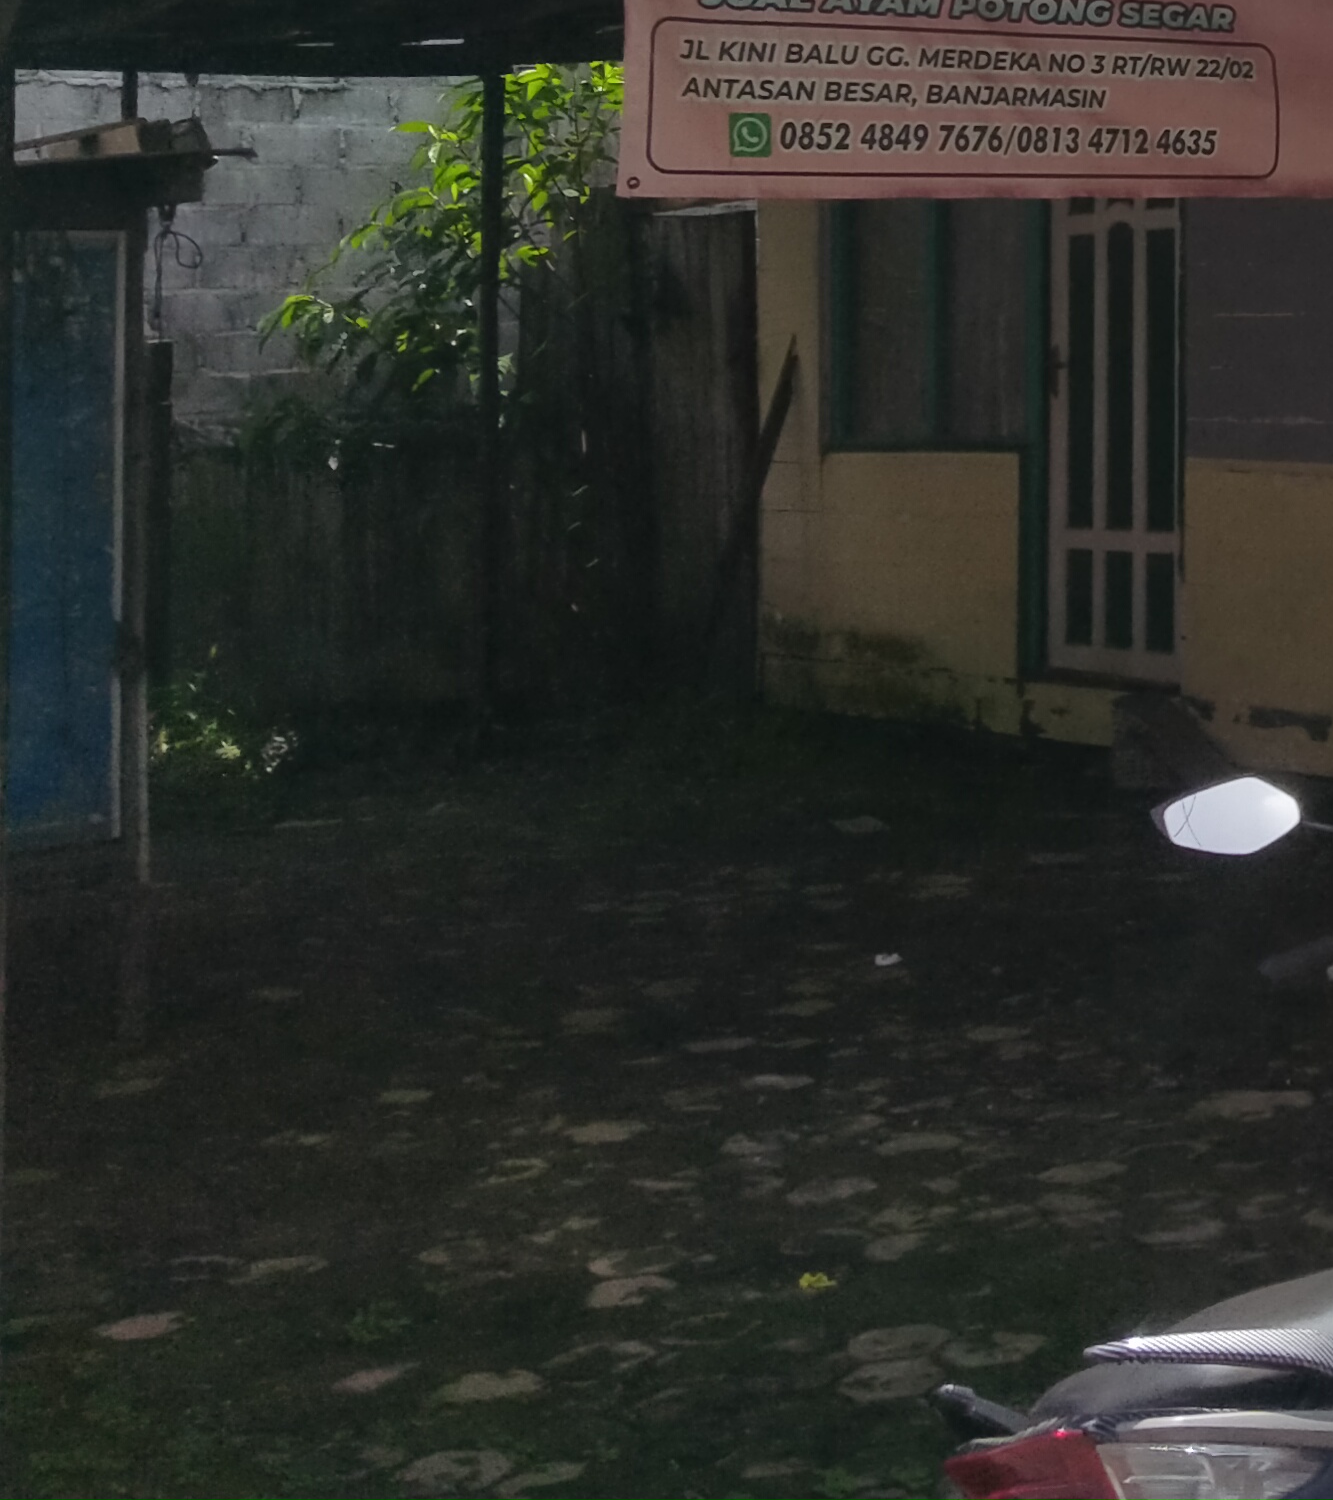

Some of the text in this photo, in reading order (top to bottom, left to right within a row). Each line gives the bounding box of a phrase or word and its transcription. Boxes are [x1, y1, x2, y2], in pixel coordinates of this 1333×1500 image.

[680, 40, 1254, 80] JL KINI BALU GG. MERDEKA NO 3 RT/RW 22/02
[682, 77, 1107, 110] ANTASAN BESAR, BANJARMASIN
[780, 122, 1217, 157] 0852 4849 7676/0813 4712 4635
